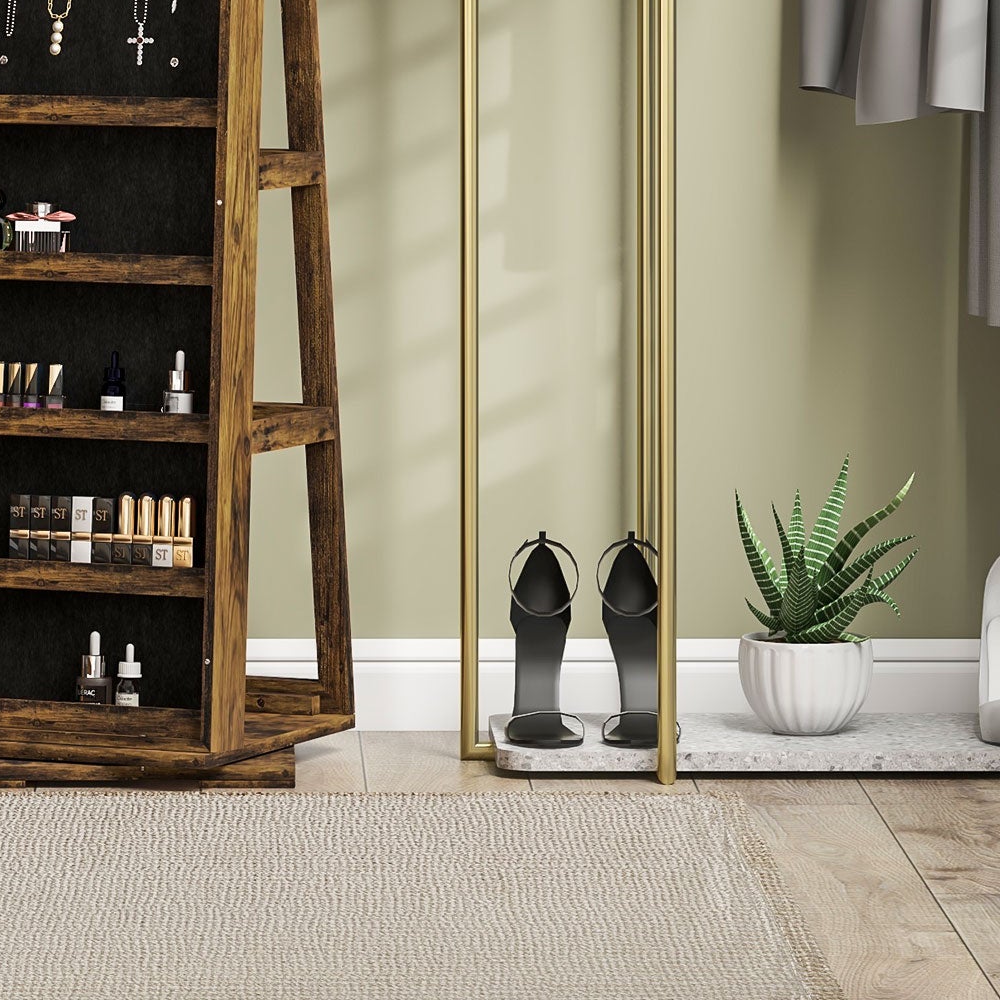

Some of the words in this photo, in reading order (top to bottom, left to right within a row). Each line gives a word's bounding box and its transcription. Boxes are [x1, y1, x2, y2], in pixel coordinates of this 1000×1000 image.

[75, 509, 88, 521] ST
[95, 509, 108, 521] ST
[155, 548, 168, 561] ST
[176, 550, 189, 561] ST
